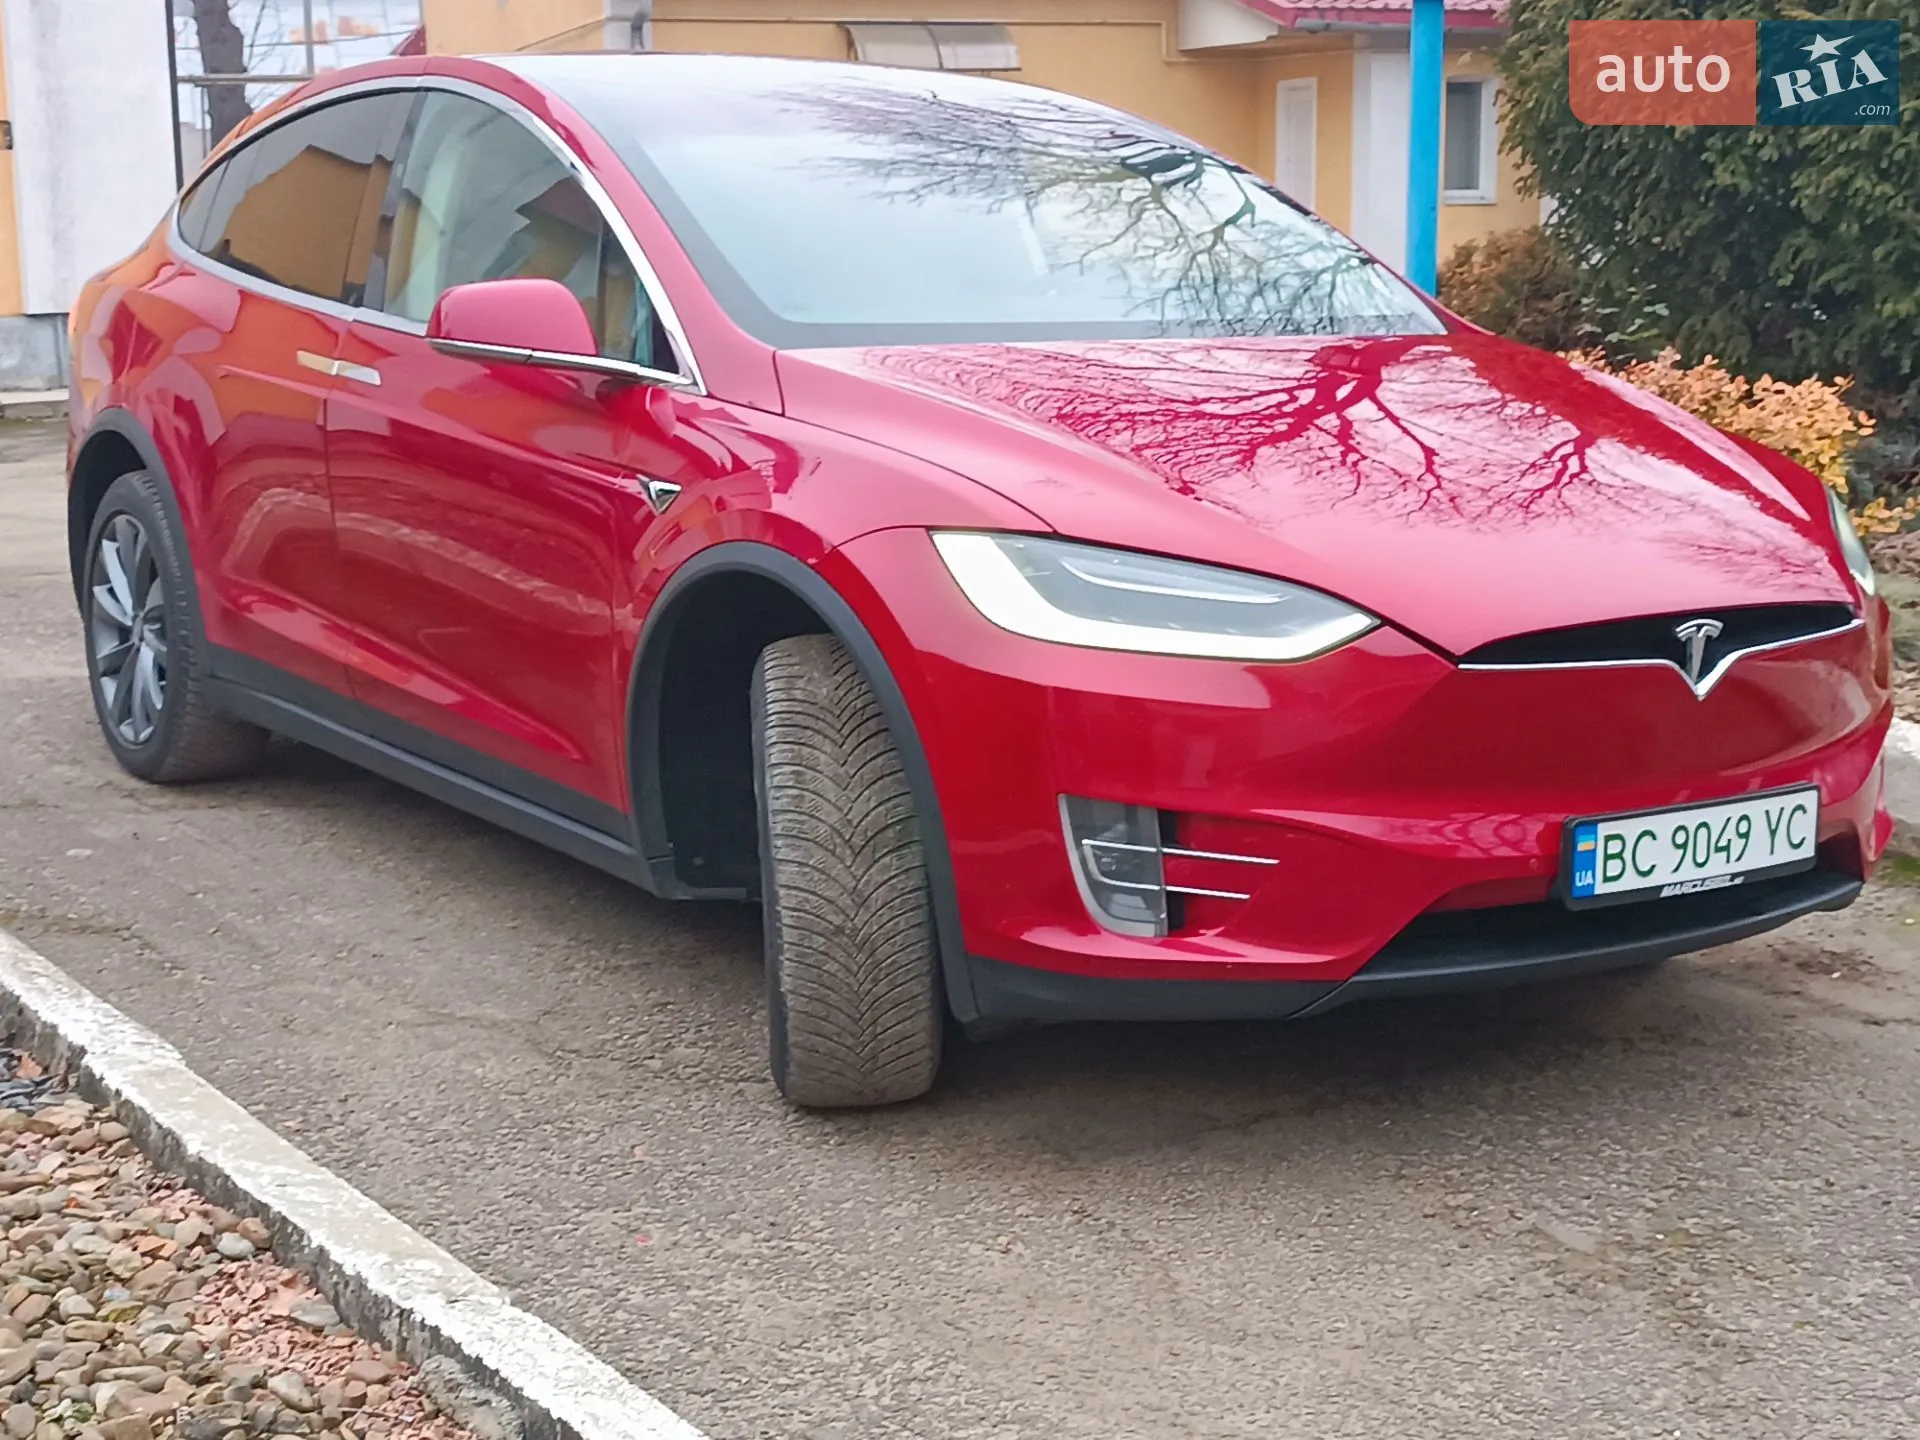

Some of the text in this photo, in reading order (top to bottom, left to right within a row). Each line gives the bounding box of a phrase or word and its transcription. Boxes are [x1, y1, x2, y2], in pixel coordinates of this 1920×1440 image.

[1602, 803, 1808, 883] BC 9049 YC
[1575, 870, 1594, 887] UA
